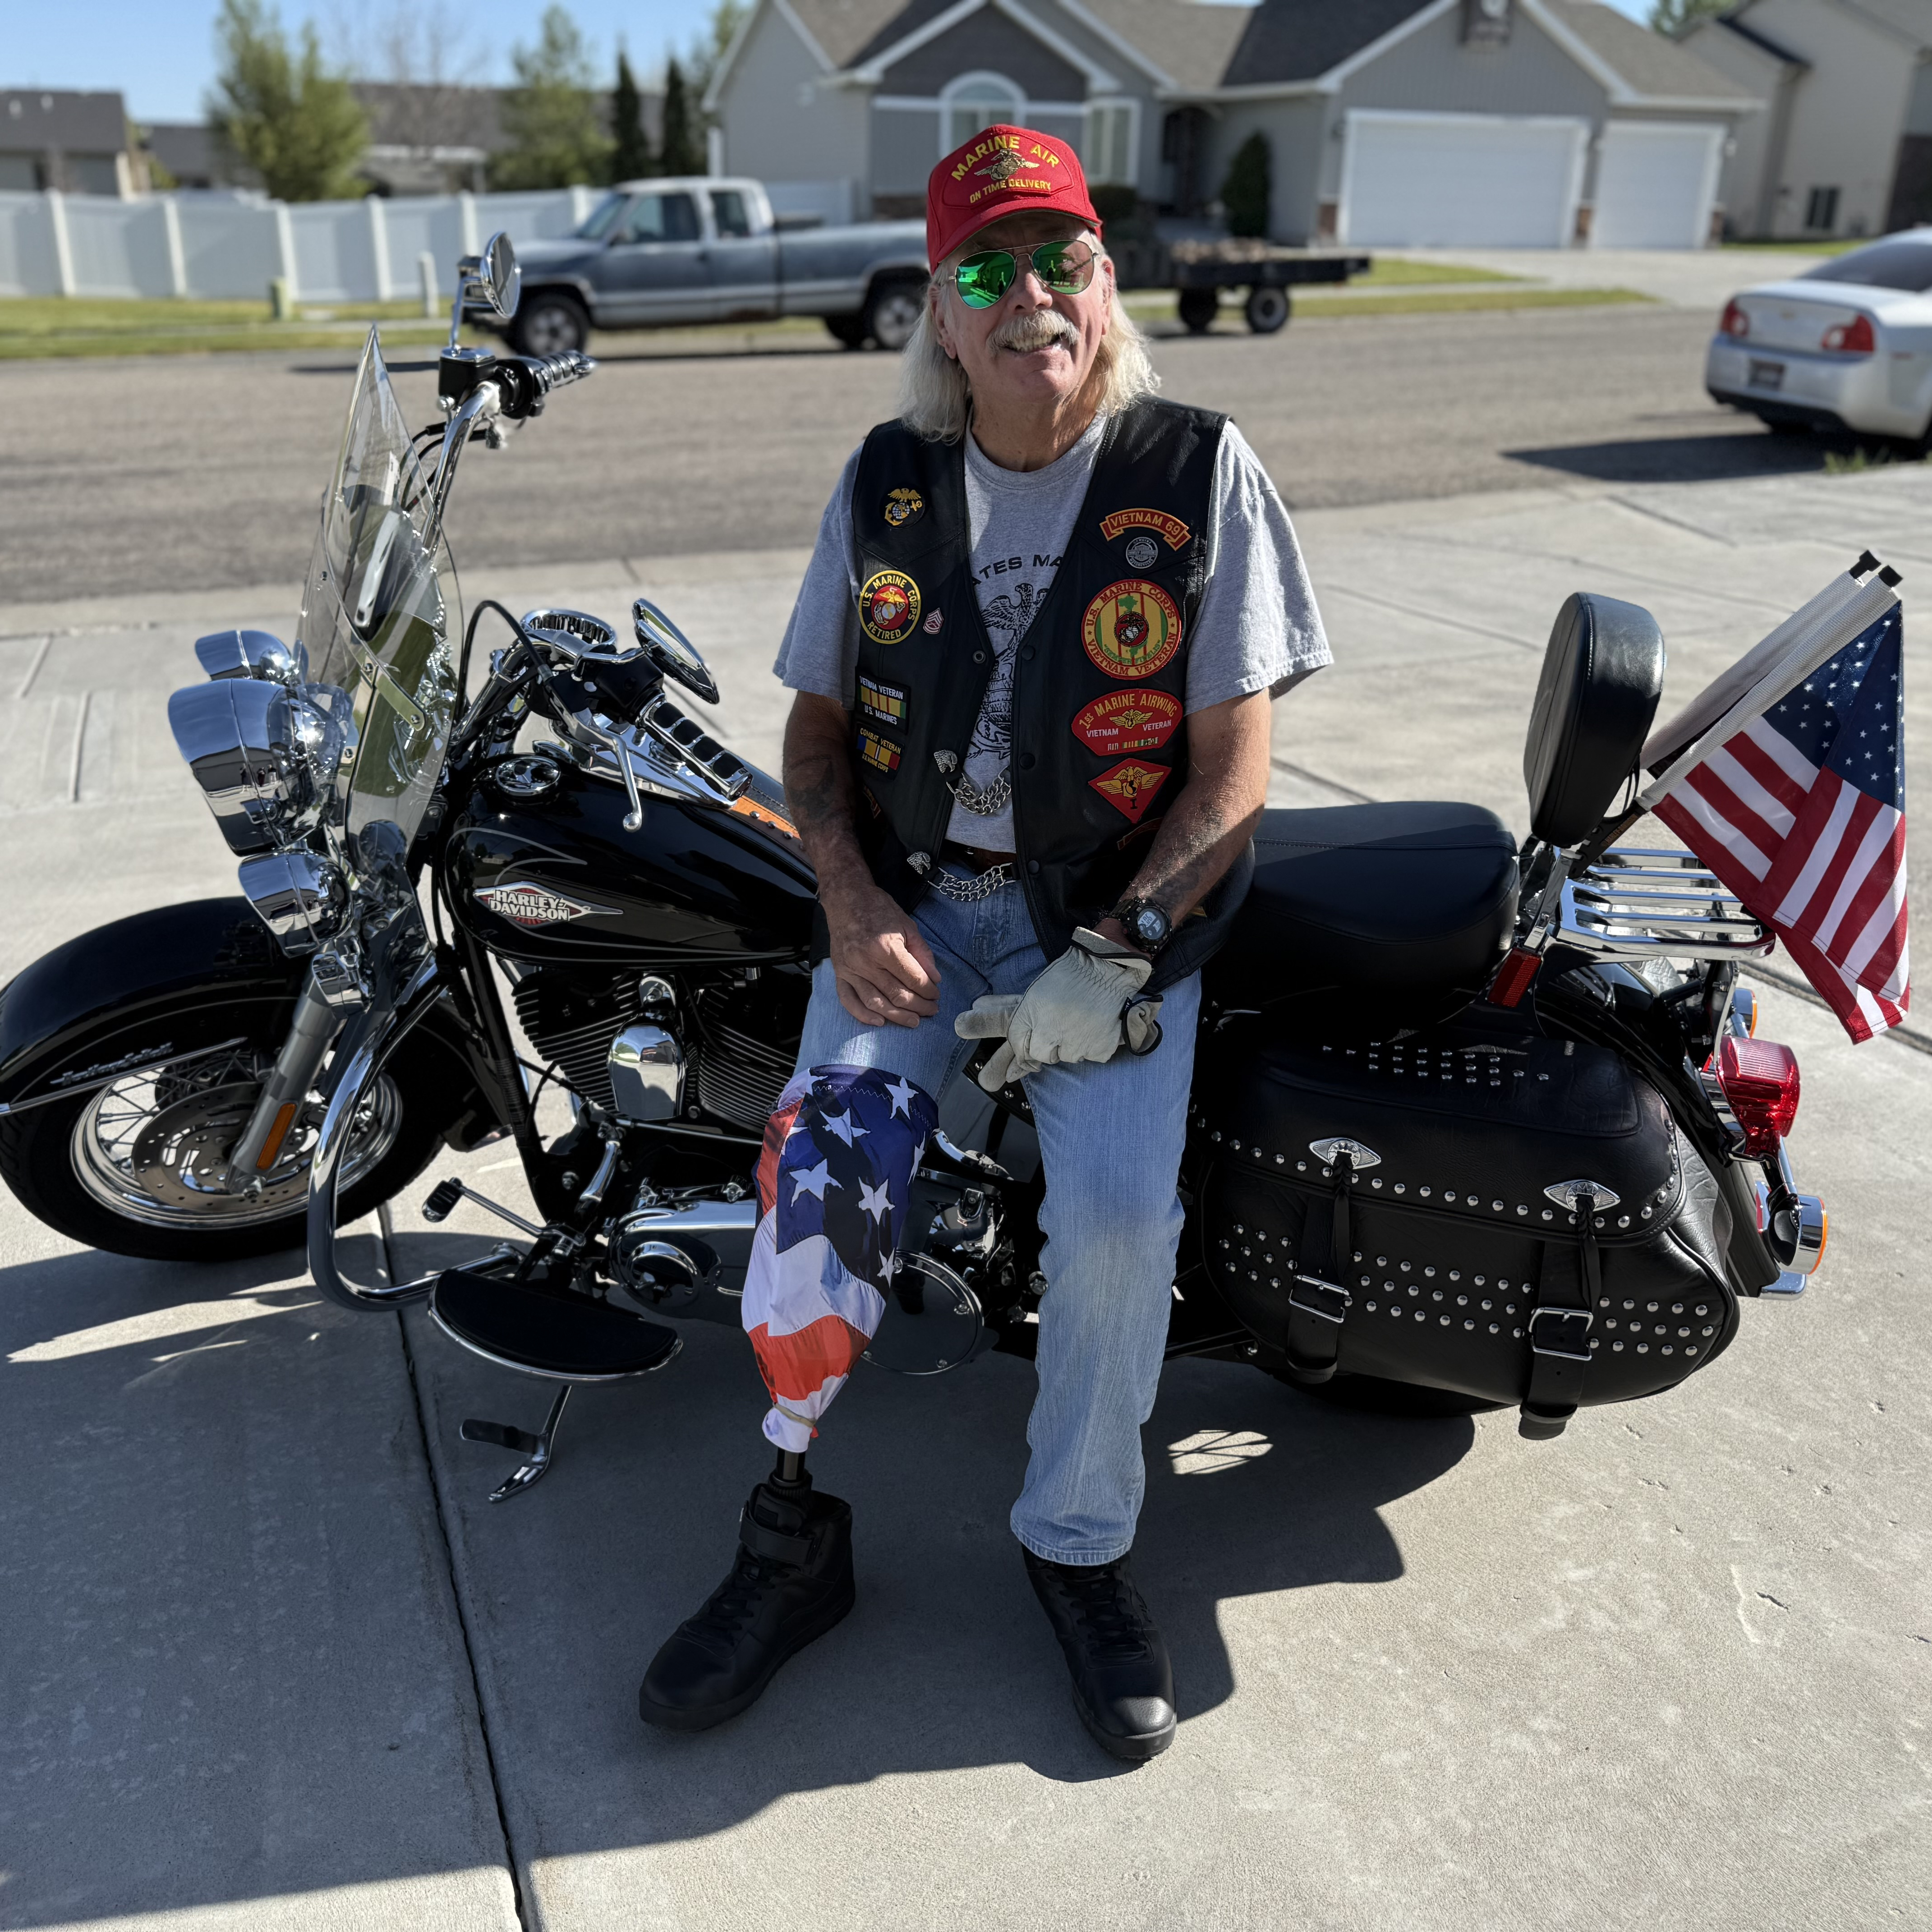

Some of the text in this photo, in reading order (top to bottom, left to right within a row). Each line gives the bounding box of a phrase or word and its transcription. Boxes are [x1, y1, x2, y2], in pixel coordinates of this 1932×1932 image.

[952, 136, 1060, 181] MARINE AIR
[970, 179, 1051, 203] ON TIME DELIVERY
[1110, 512, 1181, 535] VIETNAM 69
[863, 575, 918, 621] U.S. MARINE CORPS
[1086, 582, 1176, 626] U.S. MARINE CORPS
[867, 621, 901, 639] RETIRED
[1088, 632, 1177, 676] VIETNAM VETERAN
[879, 685, 903, 699] VETERAN
[875, 709, 897, 725] MARINES
[1079, 693, 1177, 729] 1st MARINE AIRWING
[1086, 719, 1172, 738] VIETNAM VETERAN
[860, 728, 901, 754] COMBAT VETERAN
[878, 763, 888, 773] CORPS
[491, 901, 568, 920] DAVIDSON
[495, 890, 566, 908] HARLEY-
